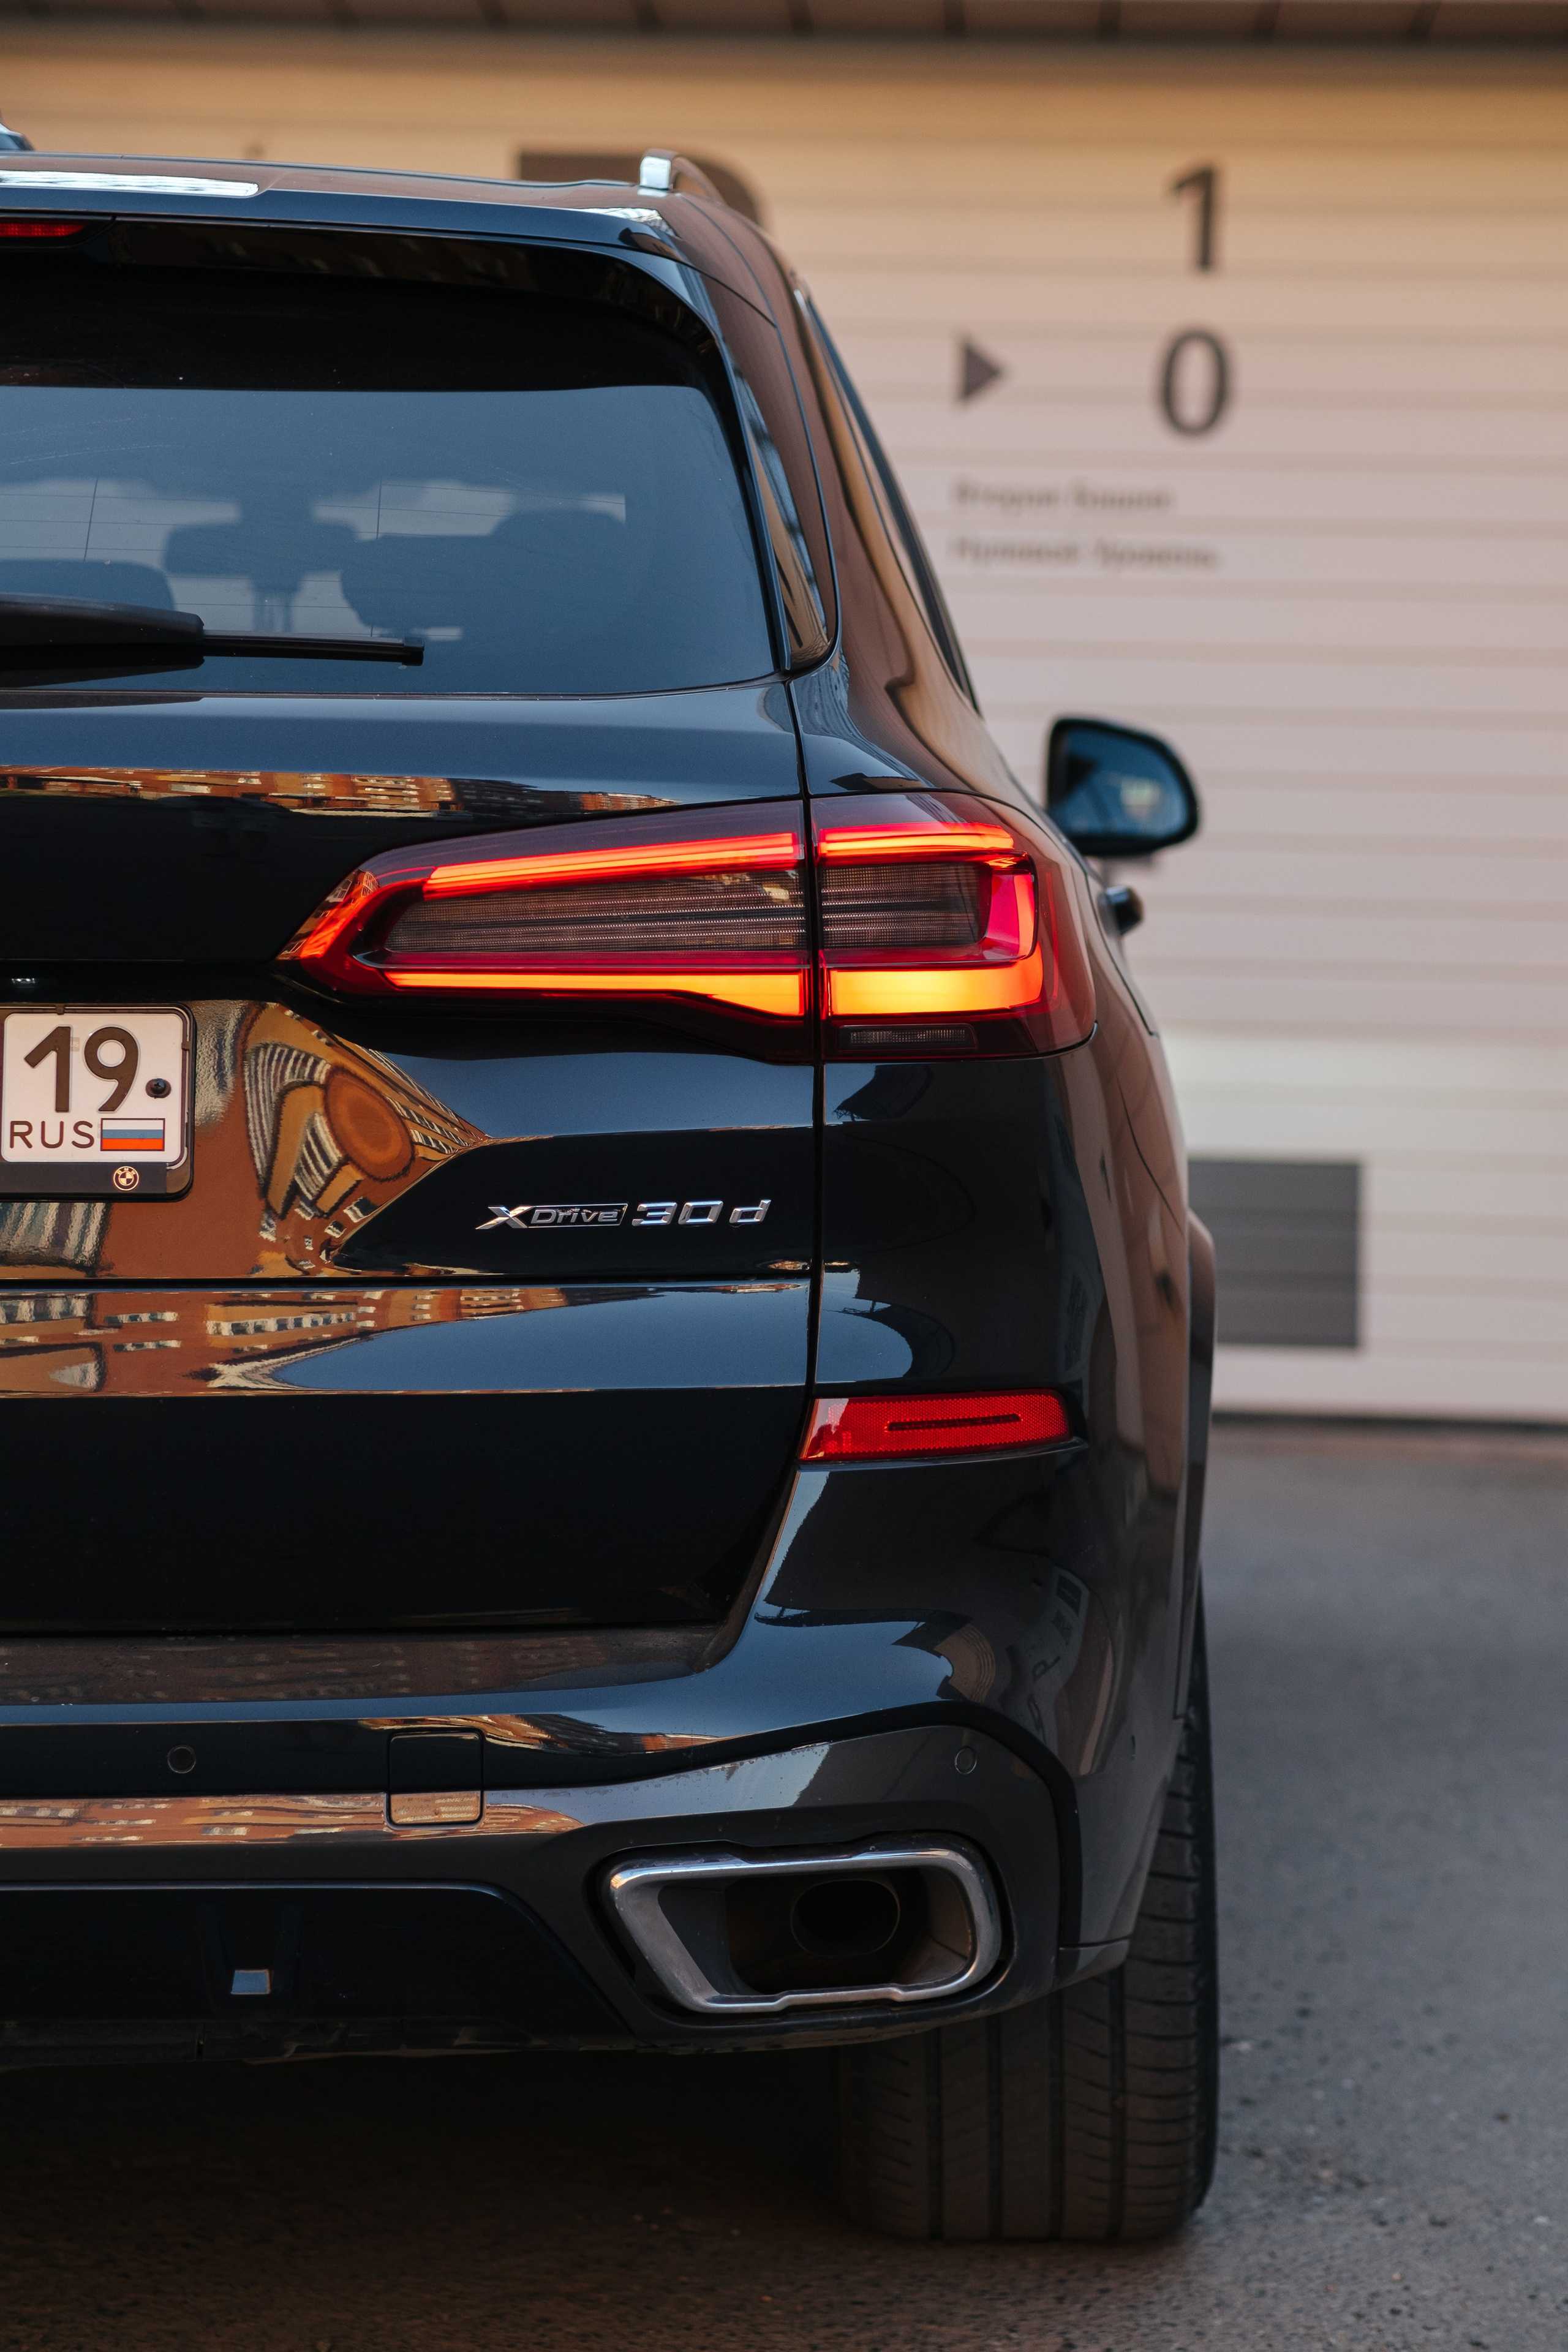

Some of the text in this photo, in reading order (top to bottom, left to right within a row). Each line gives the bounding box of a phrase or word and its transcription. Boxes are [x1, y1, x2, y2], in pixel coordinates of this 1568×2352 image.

[1169, 161, 1218, 273] 1
[1159, 328, 1230, 439] 0
[24, 1026, 139, 1113] 19
[10, 1120, 95, 1149] RUS
